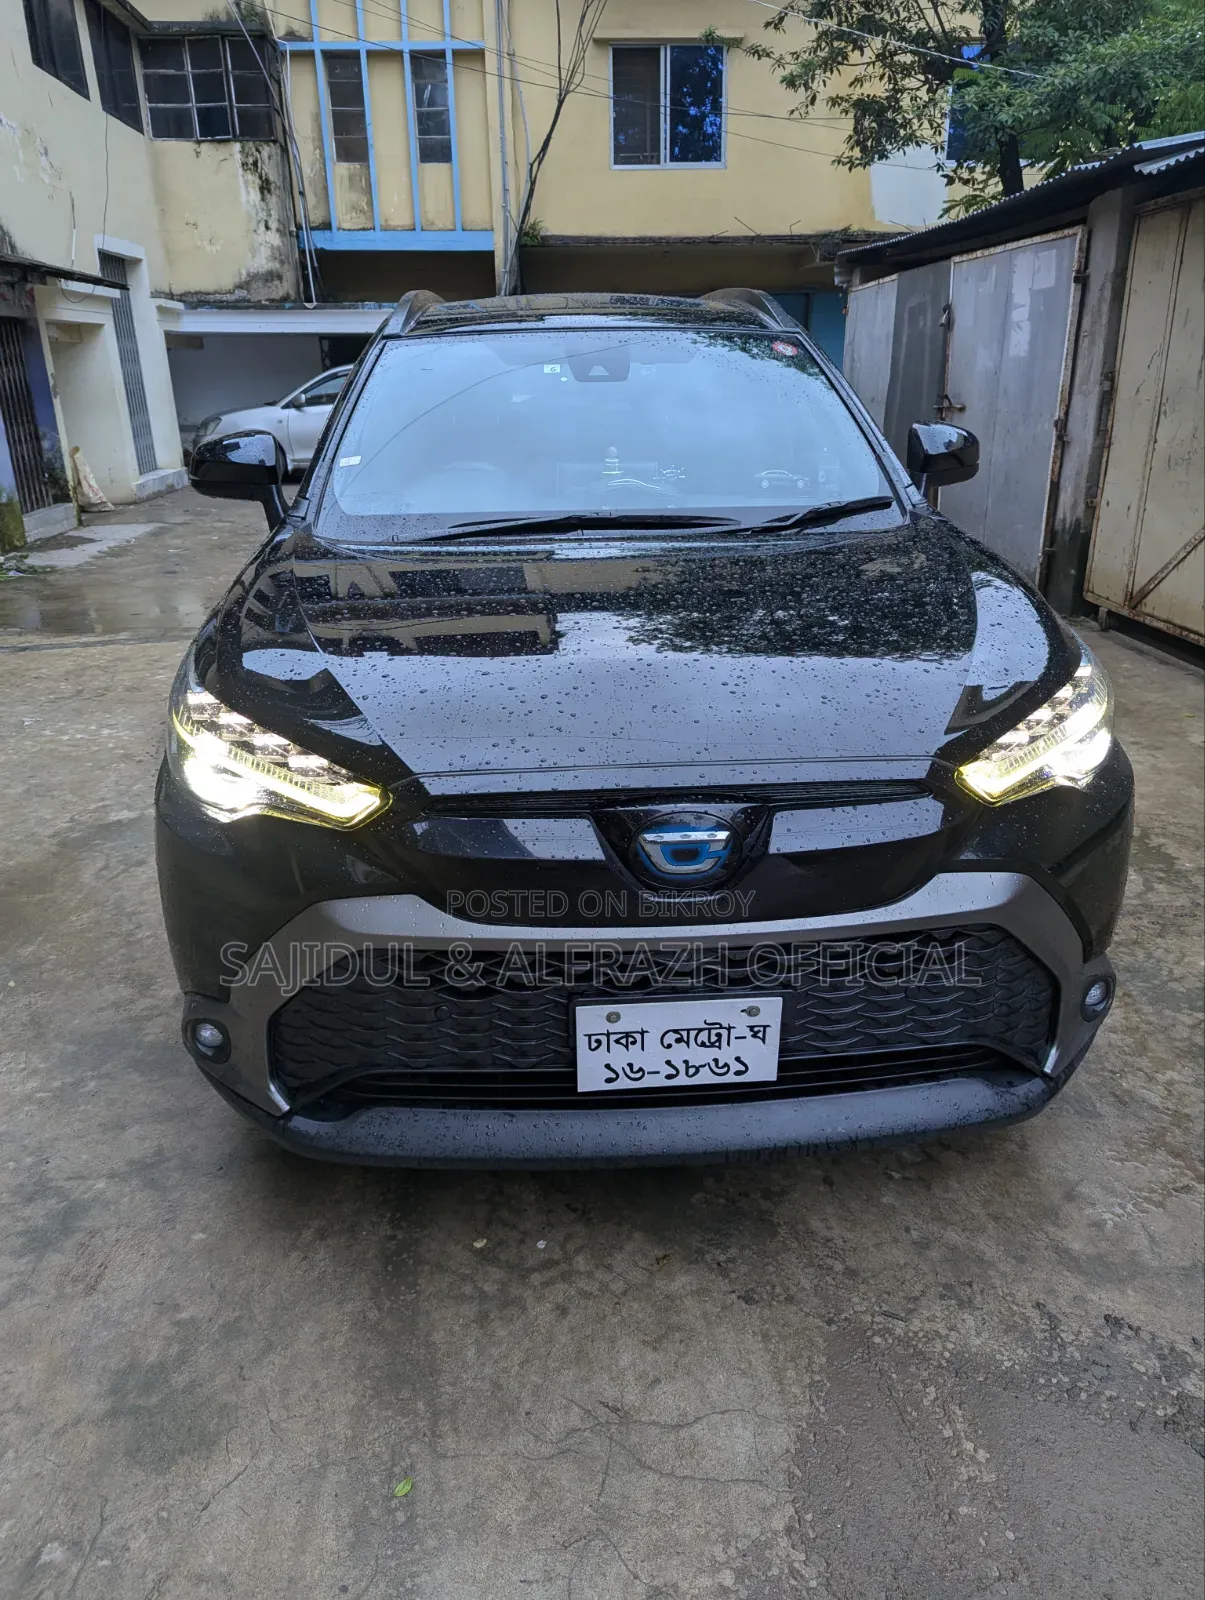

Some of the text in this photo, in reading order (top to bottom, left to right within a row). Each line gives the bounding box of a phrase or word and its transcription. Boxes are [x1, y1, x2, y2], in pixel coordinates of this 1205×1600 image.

[583, 1019, 772, 1054] ঢাকা মেট্রো-ঘ
[603, 1055, 750, 1084] ১৬-১৮৬১
